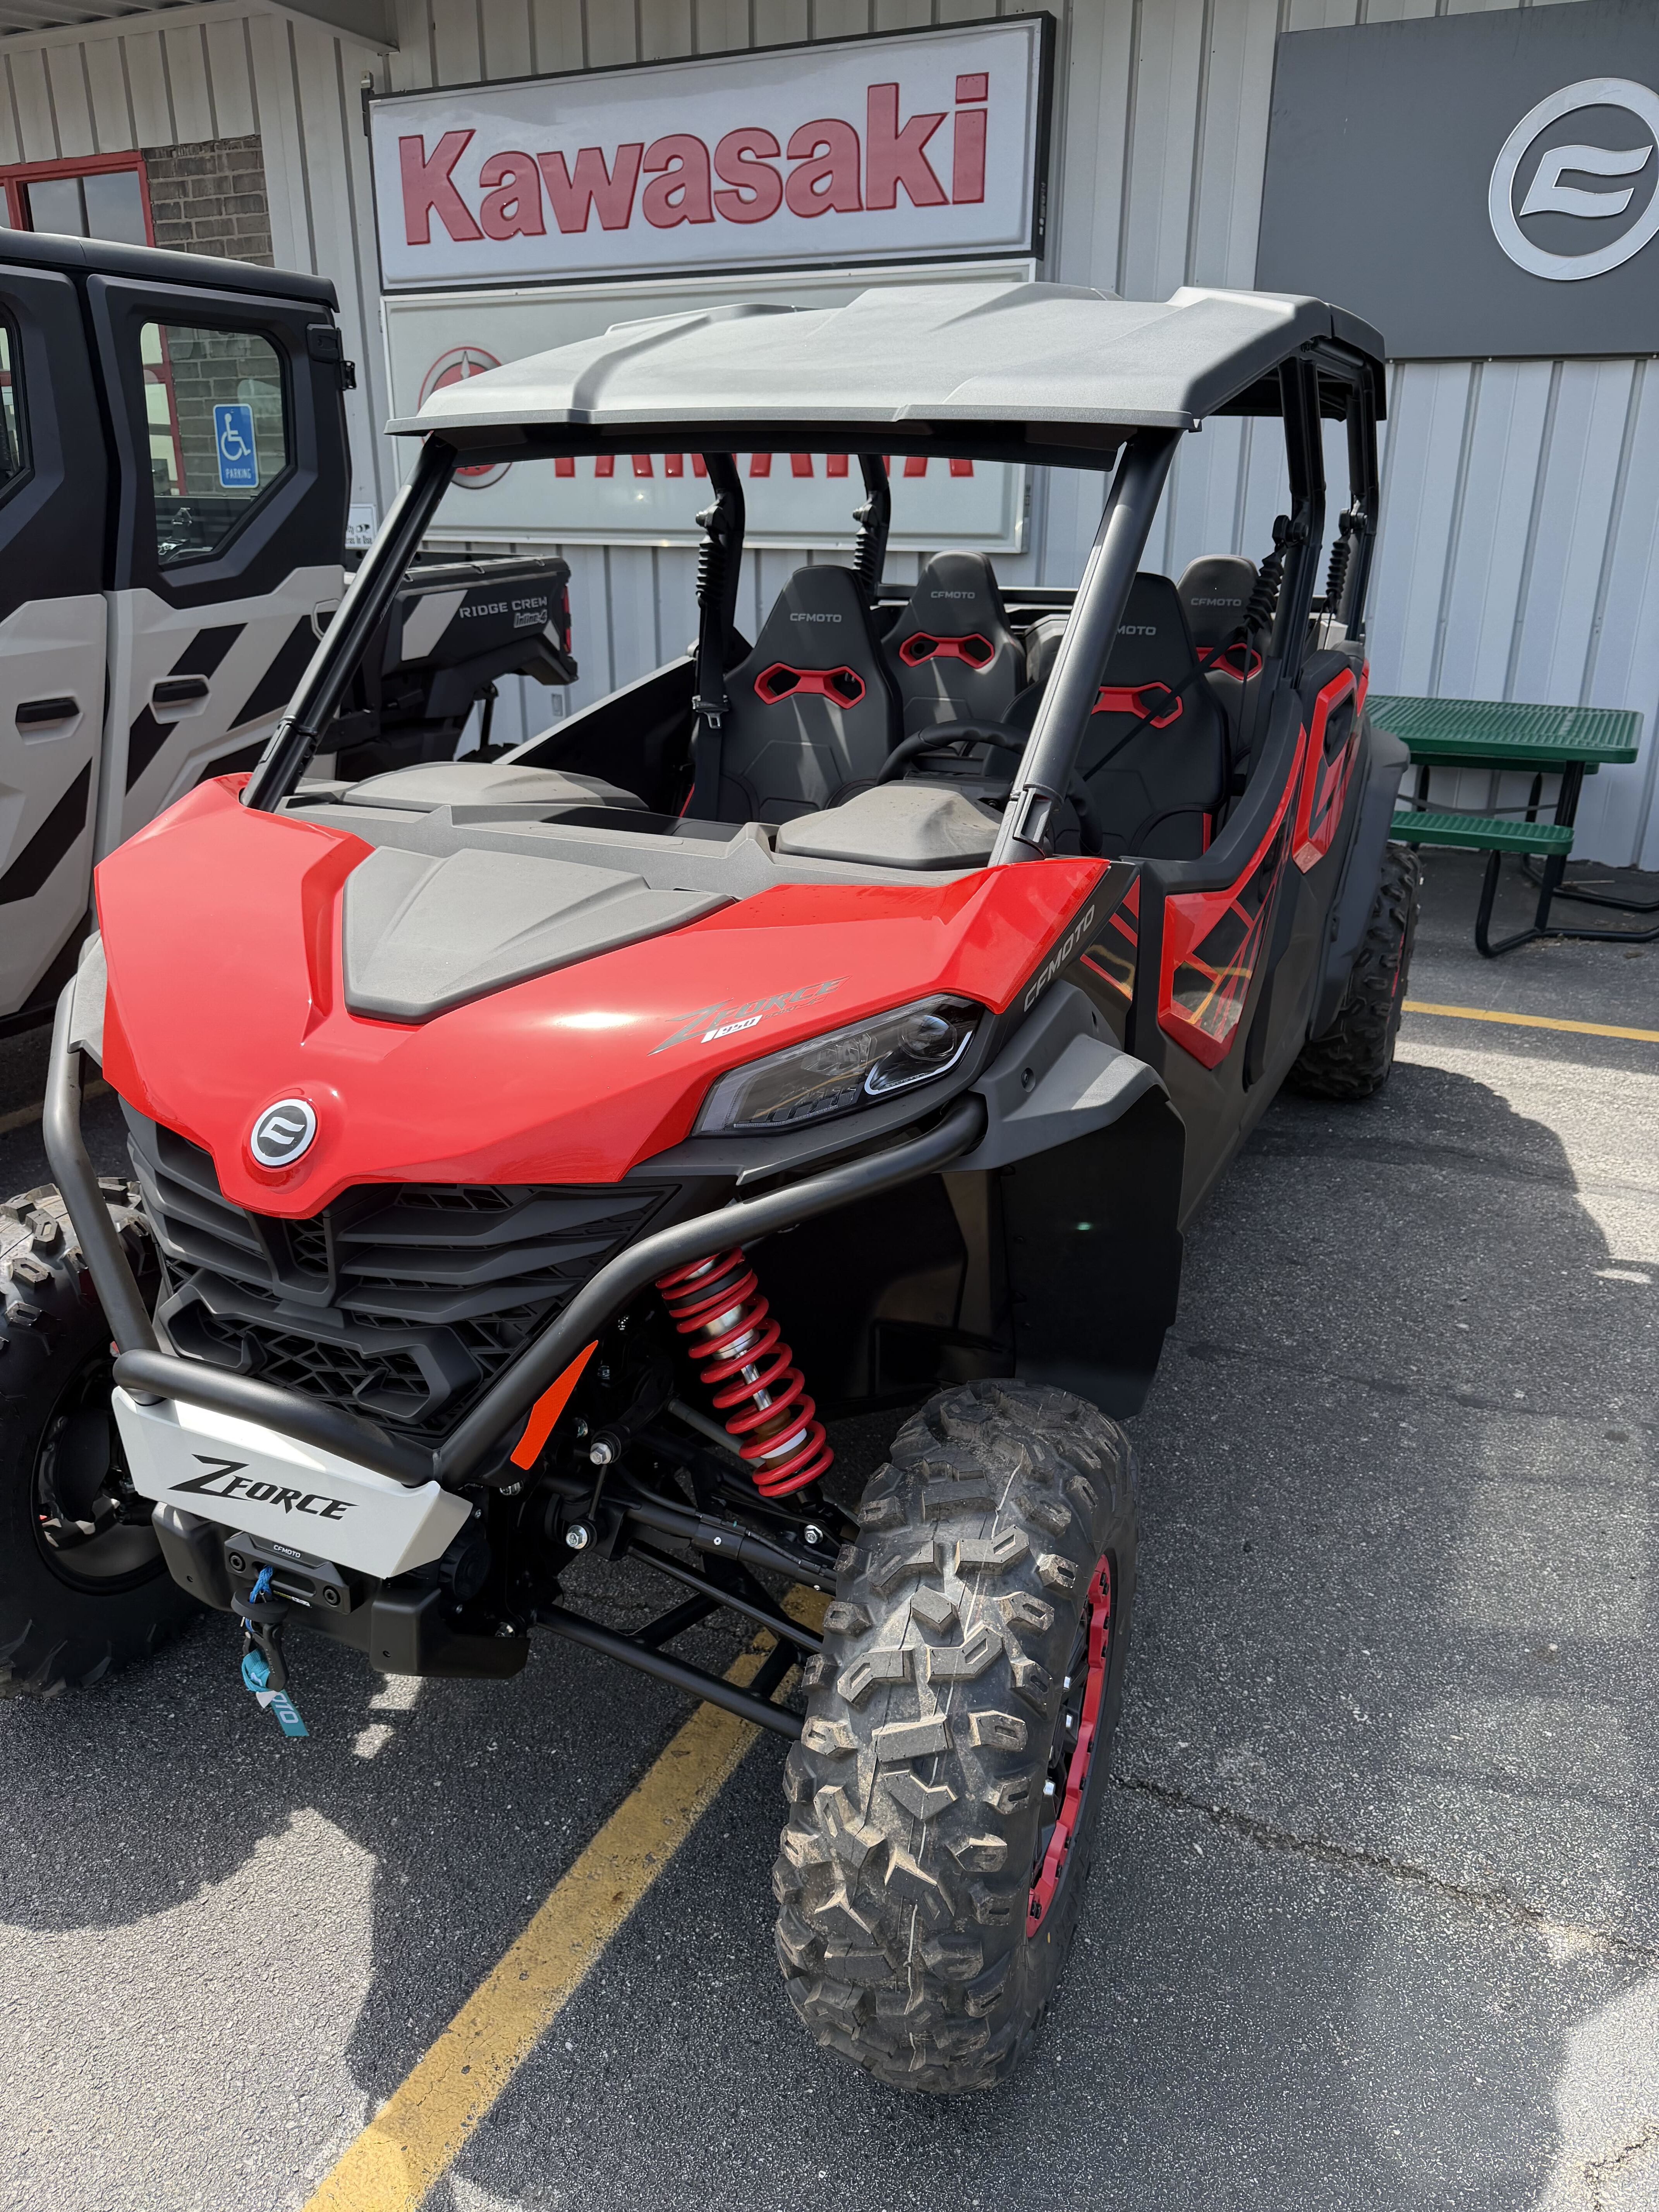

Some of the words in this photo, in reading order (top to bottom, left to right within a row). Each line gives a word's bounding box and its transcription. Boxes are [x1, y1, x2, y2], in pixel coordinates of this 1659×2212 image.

[398, 72, 989, 246] Kawasaki
[225, 468, 251, 479] PARKING
[931, 591, 975, 599] CFMOTO
[460, 602, 508, 618] RIDGE
[512, 596, 547, 611] CREW
[1190, 598, 1242, 607] CFMOTO
[790, 613, 842, 623] CFMOTO
[1116, 625, 1156, 635] MOTO
[1024, 905, 1095, 1012] CFMOTO
[722, 1018, 756, 1034] 950
[167, 1454, 360, 1520] ZFORCE
[273, 1544, 301, 1558] CFMOTO
